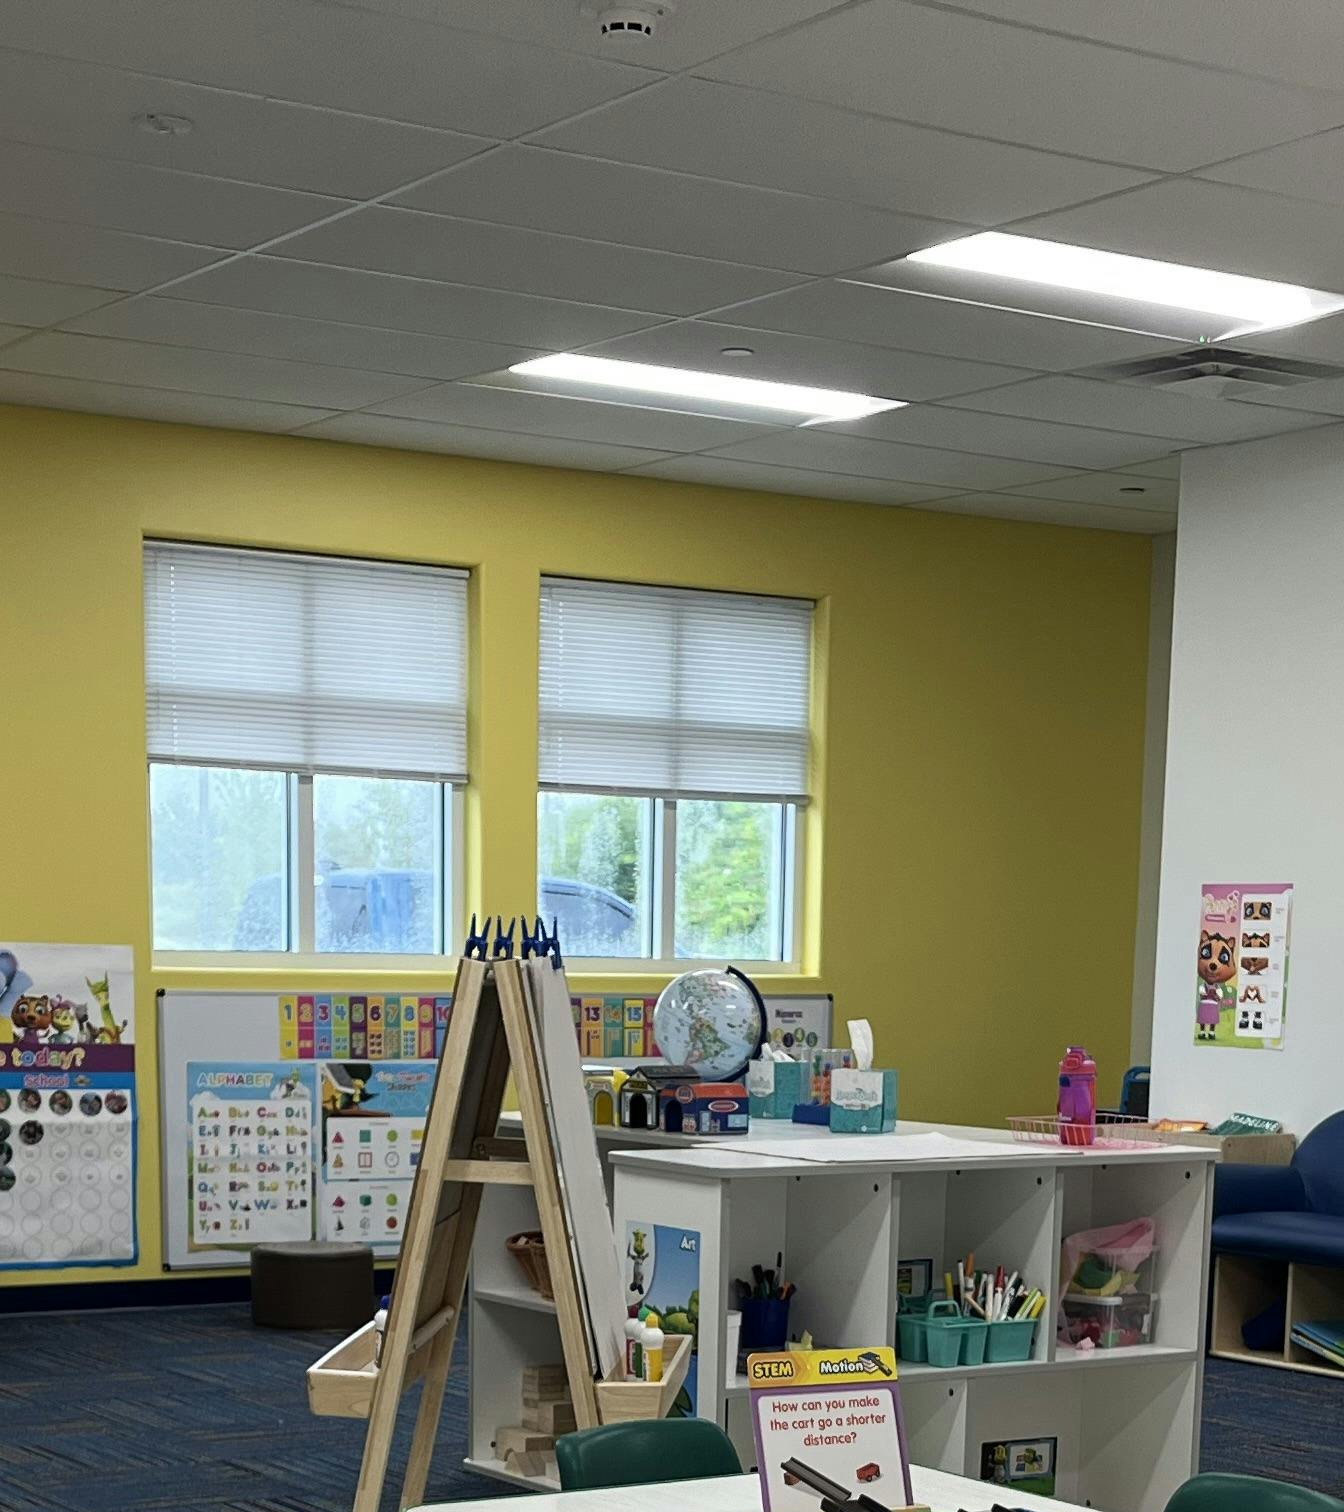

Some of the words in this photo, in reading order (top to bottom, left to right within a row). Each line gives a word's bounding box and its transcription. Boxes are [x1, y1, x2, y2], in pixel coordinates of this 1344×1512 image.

[284, 1005, 292, 1021] 1
[318, 1005, 329, 1021] 3
[335, 1005, 347, 1021] 4
[370, 1006, 381, 1021] 6
[387, 1005, 400, 1023] 7
[404, 1006, 414, 1021] 8
[584, 1006, 600, 1021] 13
[627, 1006, 642, 1021] 15
[11, 1047, 86, 1070] today?
[197, 1072, 274, 1088] ALPHABET
[680, 1235, 696, 1251] Art
[753, 1361, 794, 1379] STEM
[819, 1359, 864, 1375] Motion
[772, 1401, 798, 1412] How
[801, 1401, 821, 1412] can
[825, 1400, 845, 1412] you
[849, 1395, 880, 1408] make
[770, 1419, 788, 1431] the
[792, 1418, 814, 1429] cart
[818, 1418, 832, 1430] go
[836, 1417, 843, 1426] a
[846, 1413, 886, 1426] shorter
[803, 1432, 857, 1446] distance?
